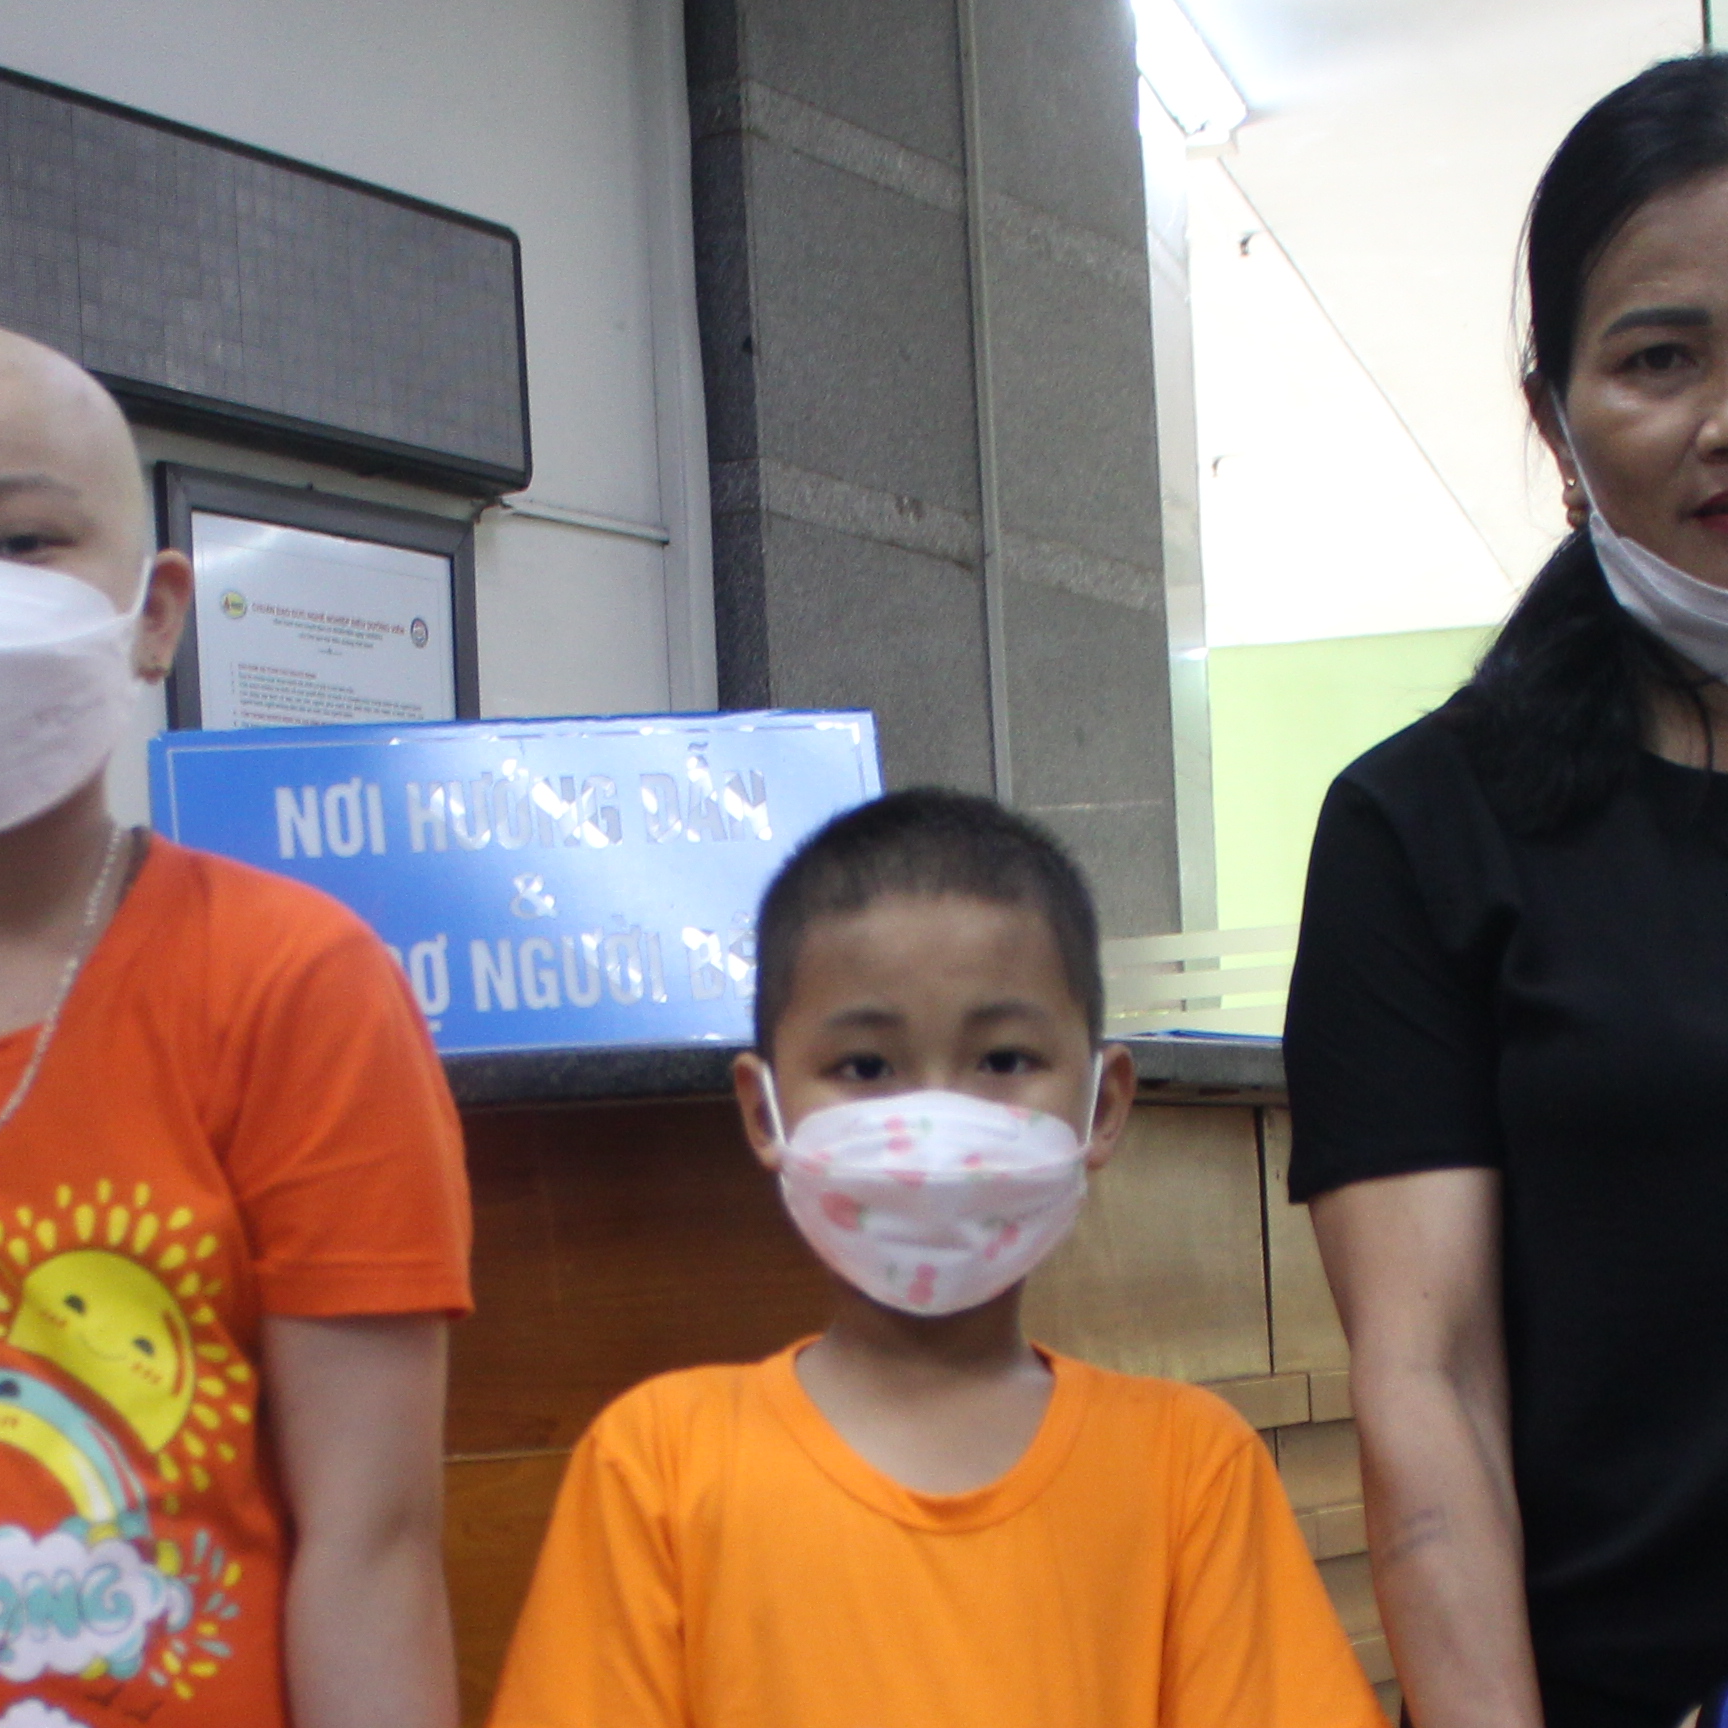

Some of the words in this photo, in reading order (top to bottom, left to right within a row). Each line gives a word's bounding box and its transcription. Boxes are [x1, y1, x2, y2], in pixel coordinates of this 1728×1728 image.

[275, 776, 387, 859] NƠI
[406, 745, 624, 853] HƯỚNG
[639, 742, 773, 844] DẪN
[510, 873, 557, 919] &
[470, 914, 667, 1012] NGƯỜI
